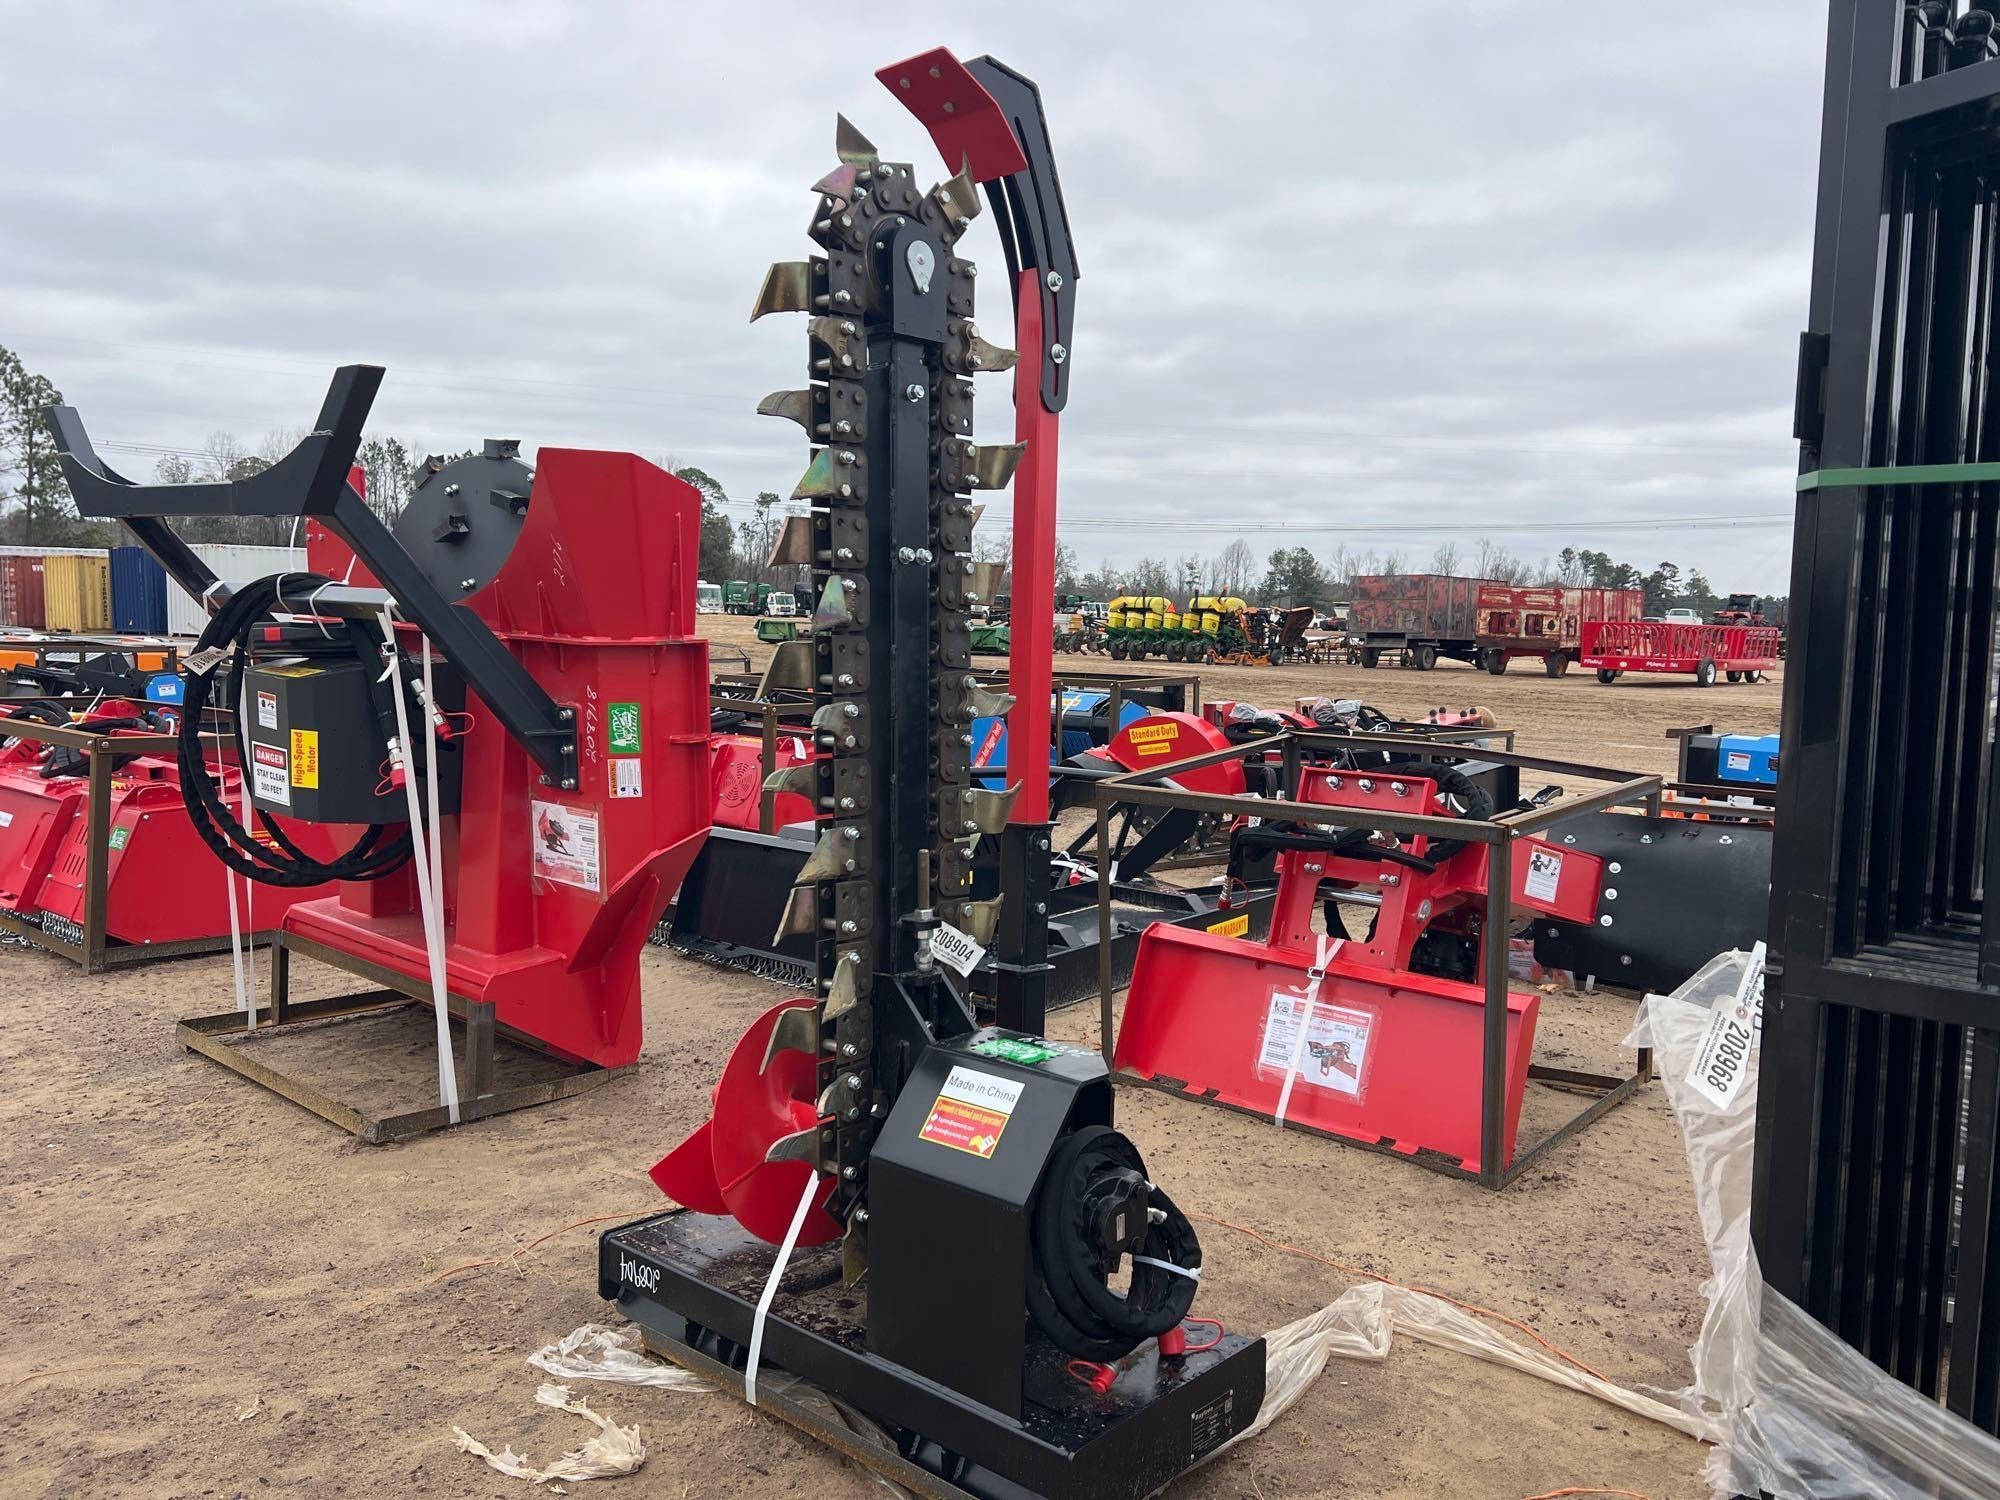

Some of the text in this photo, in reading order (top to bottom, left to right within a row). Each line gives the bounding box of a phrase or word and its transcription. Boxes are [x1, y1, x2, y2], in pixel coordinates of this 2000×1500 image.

[585, 684, 598, 764] 208918
[1131, 725, 1176, 740] Standard Duty
[256, 750, 285, 765] DANGER
[293, 731, 306, 785] High-Speed
[307, 746, 316, 773] Motor
[256, 768, 286, 783] STAY CLEAR
[261, 783, 282, 796] 300 FEET
[934, 928, 975, 962] 208904
[1707, 1020, 1751, 1093] 208968
[948, 1075, 1017, 1102] Made in China
[619, 1251, 661, 1294] 208904
